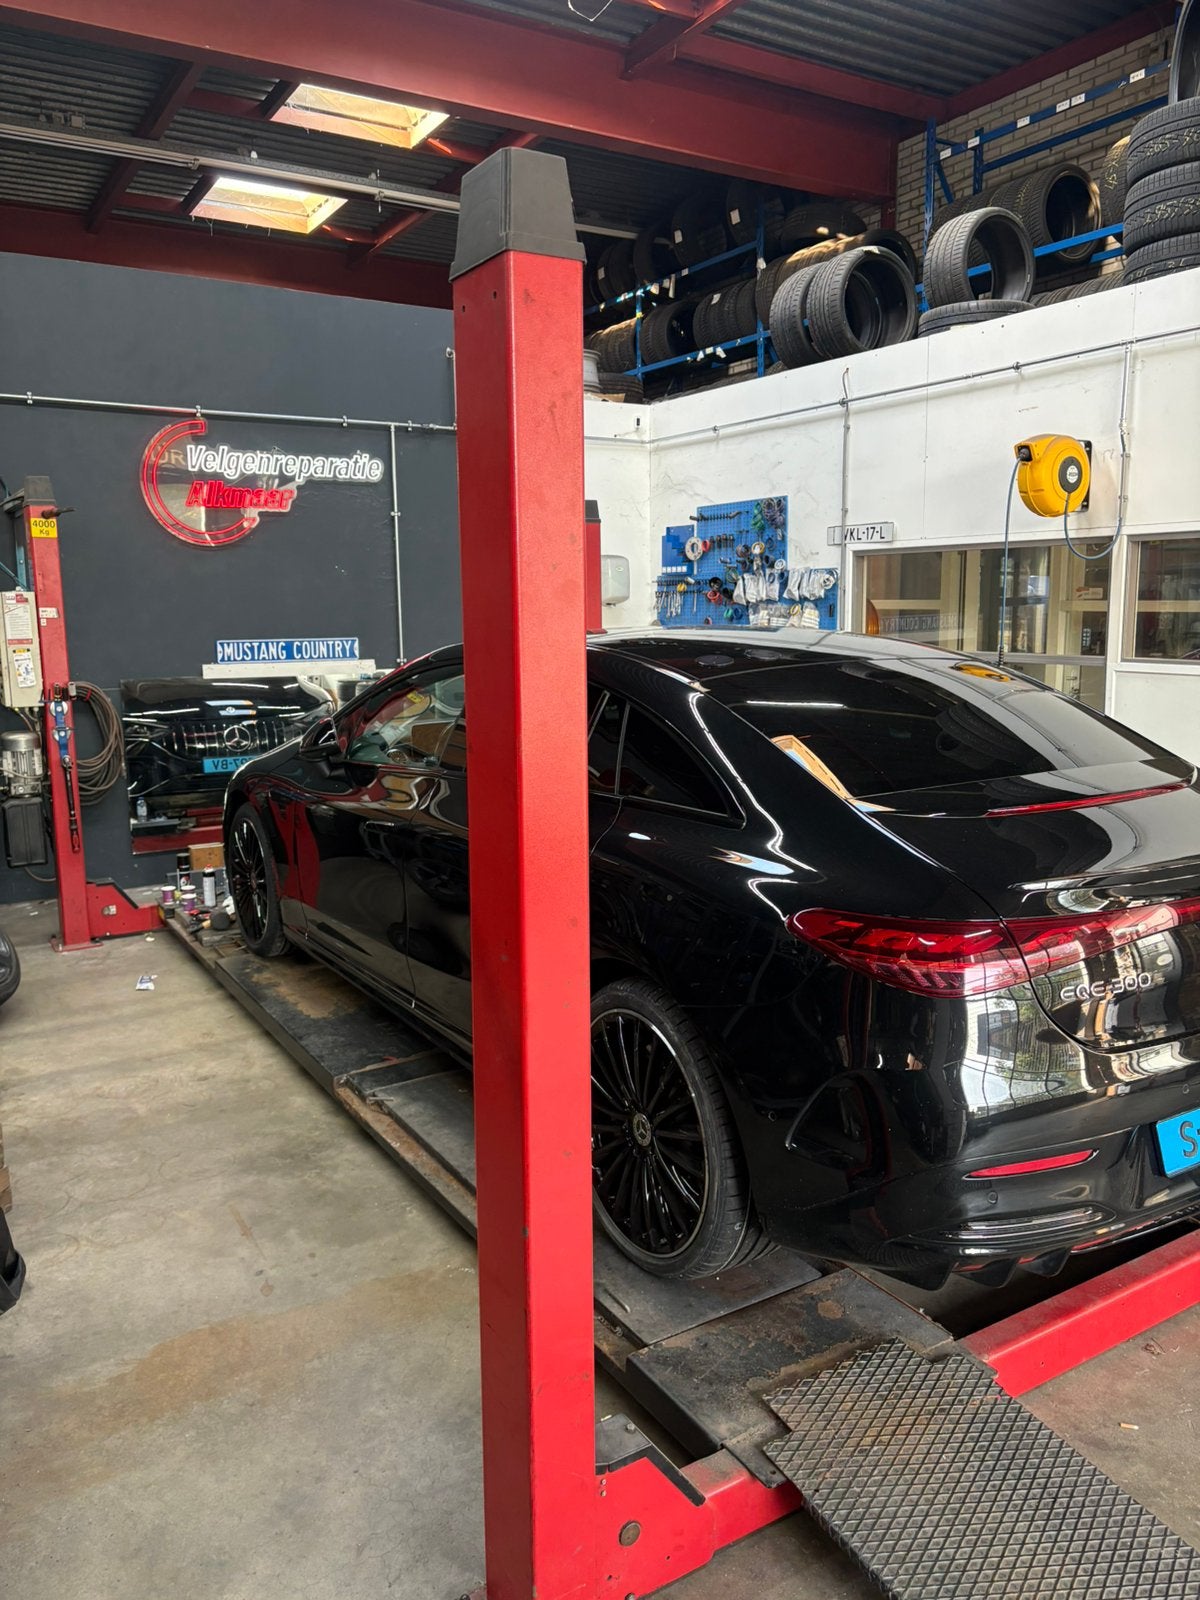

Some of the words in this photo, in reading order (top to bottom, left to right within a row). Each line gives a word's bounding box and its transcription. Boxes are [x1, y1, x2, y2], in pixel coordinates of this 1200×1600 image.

[186, 445, 383, 482] Velgenreparatie
[185, 480, 295, 511] Alkmaar
[32, 520, 56, 529] 4000
[39, 528, 50, 536] Kg
[223, 641, 287, 661] MUSTANG
[293, 640, 353, 660] COUNTRY
[1059, 980, 1106, 1002] EQE
[1110, 972, 1152, 994] 300
